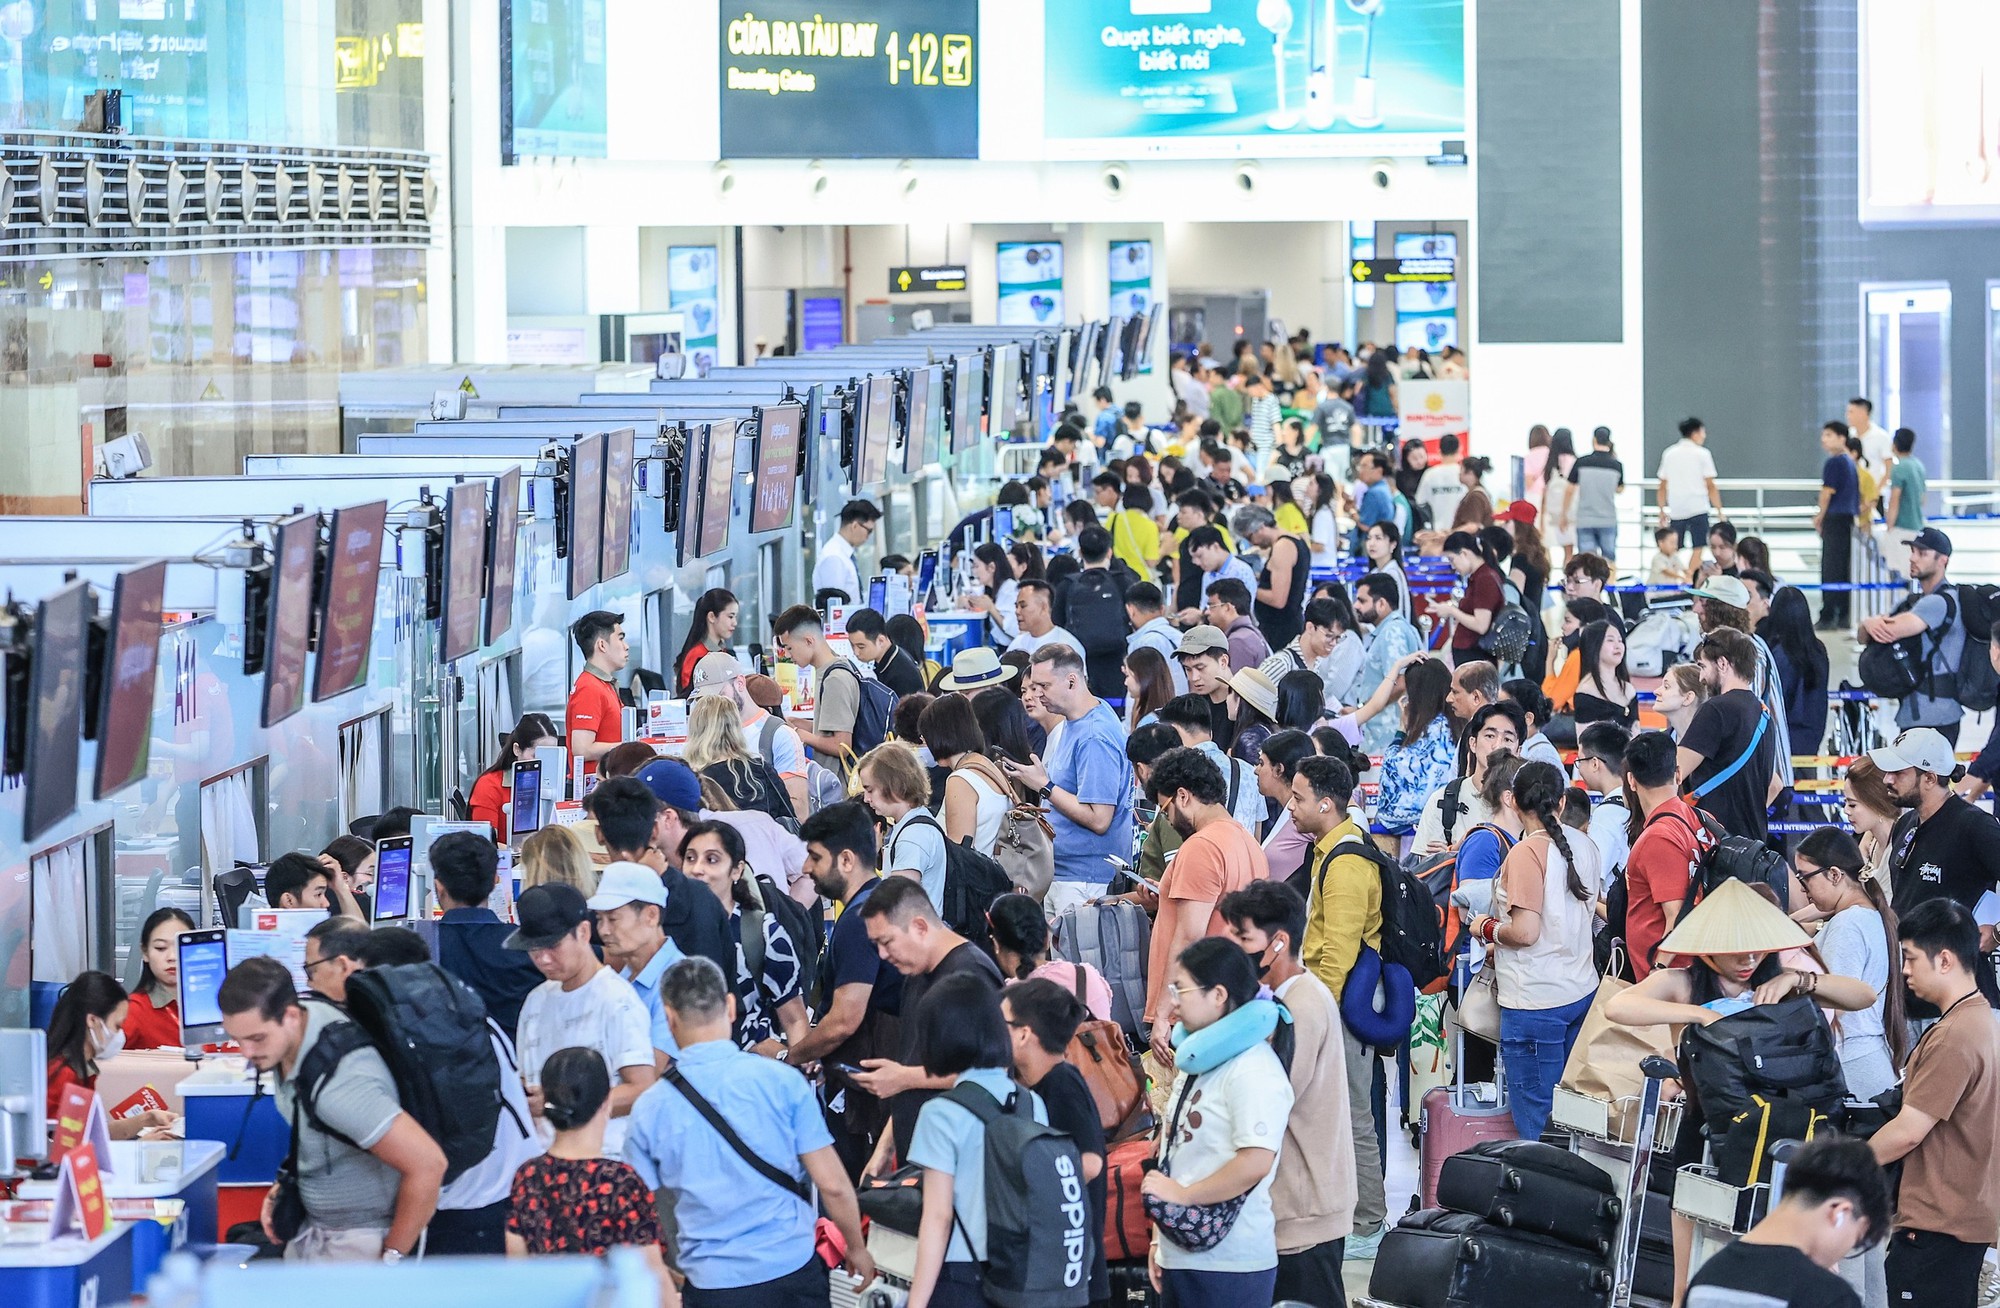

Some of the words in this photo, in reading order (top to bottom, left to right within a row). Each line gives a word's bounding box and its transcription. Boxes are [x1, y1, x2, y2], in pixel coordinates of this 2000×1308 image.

[728, 12, 771, 56] CỬA
[772, 20, 801, 56] RA
[801, 14, 840, 57] TÀU
[841, 22, 878, 57] BAY
[885, 31, 939, 86] 1-12
[1100, 25, 1150, 51] Quạt
[1152, 23, 1191, 46] biết
[1193, 24, 1246, 49] nghe,
[1139, 48, 1178, 71] biết
[1179, 49, 1210, 70] nói
[174, 639, 196, 726] A11
[1054, 1154, 1086, 1288] adidas
